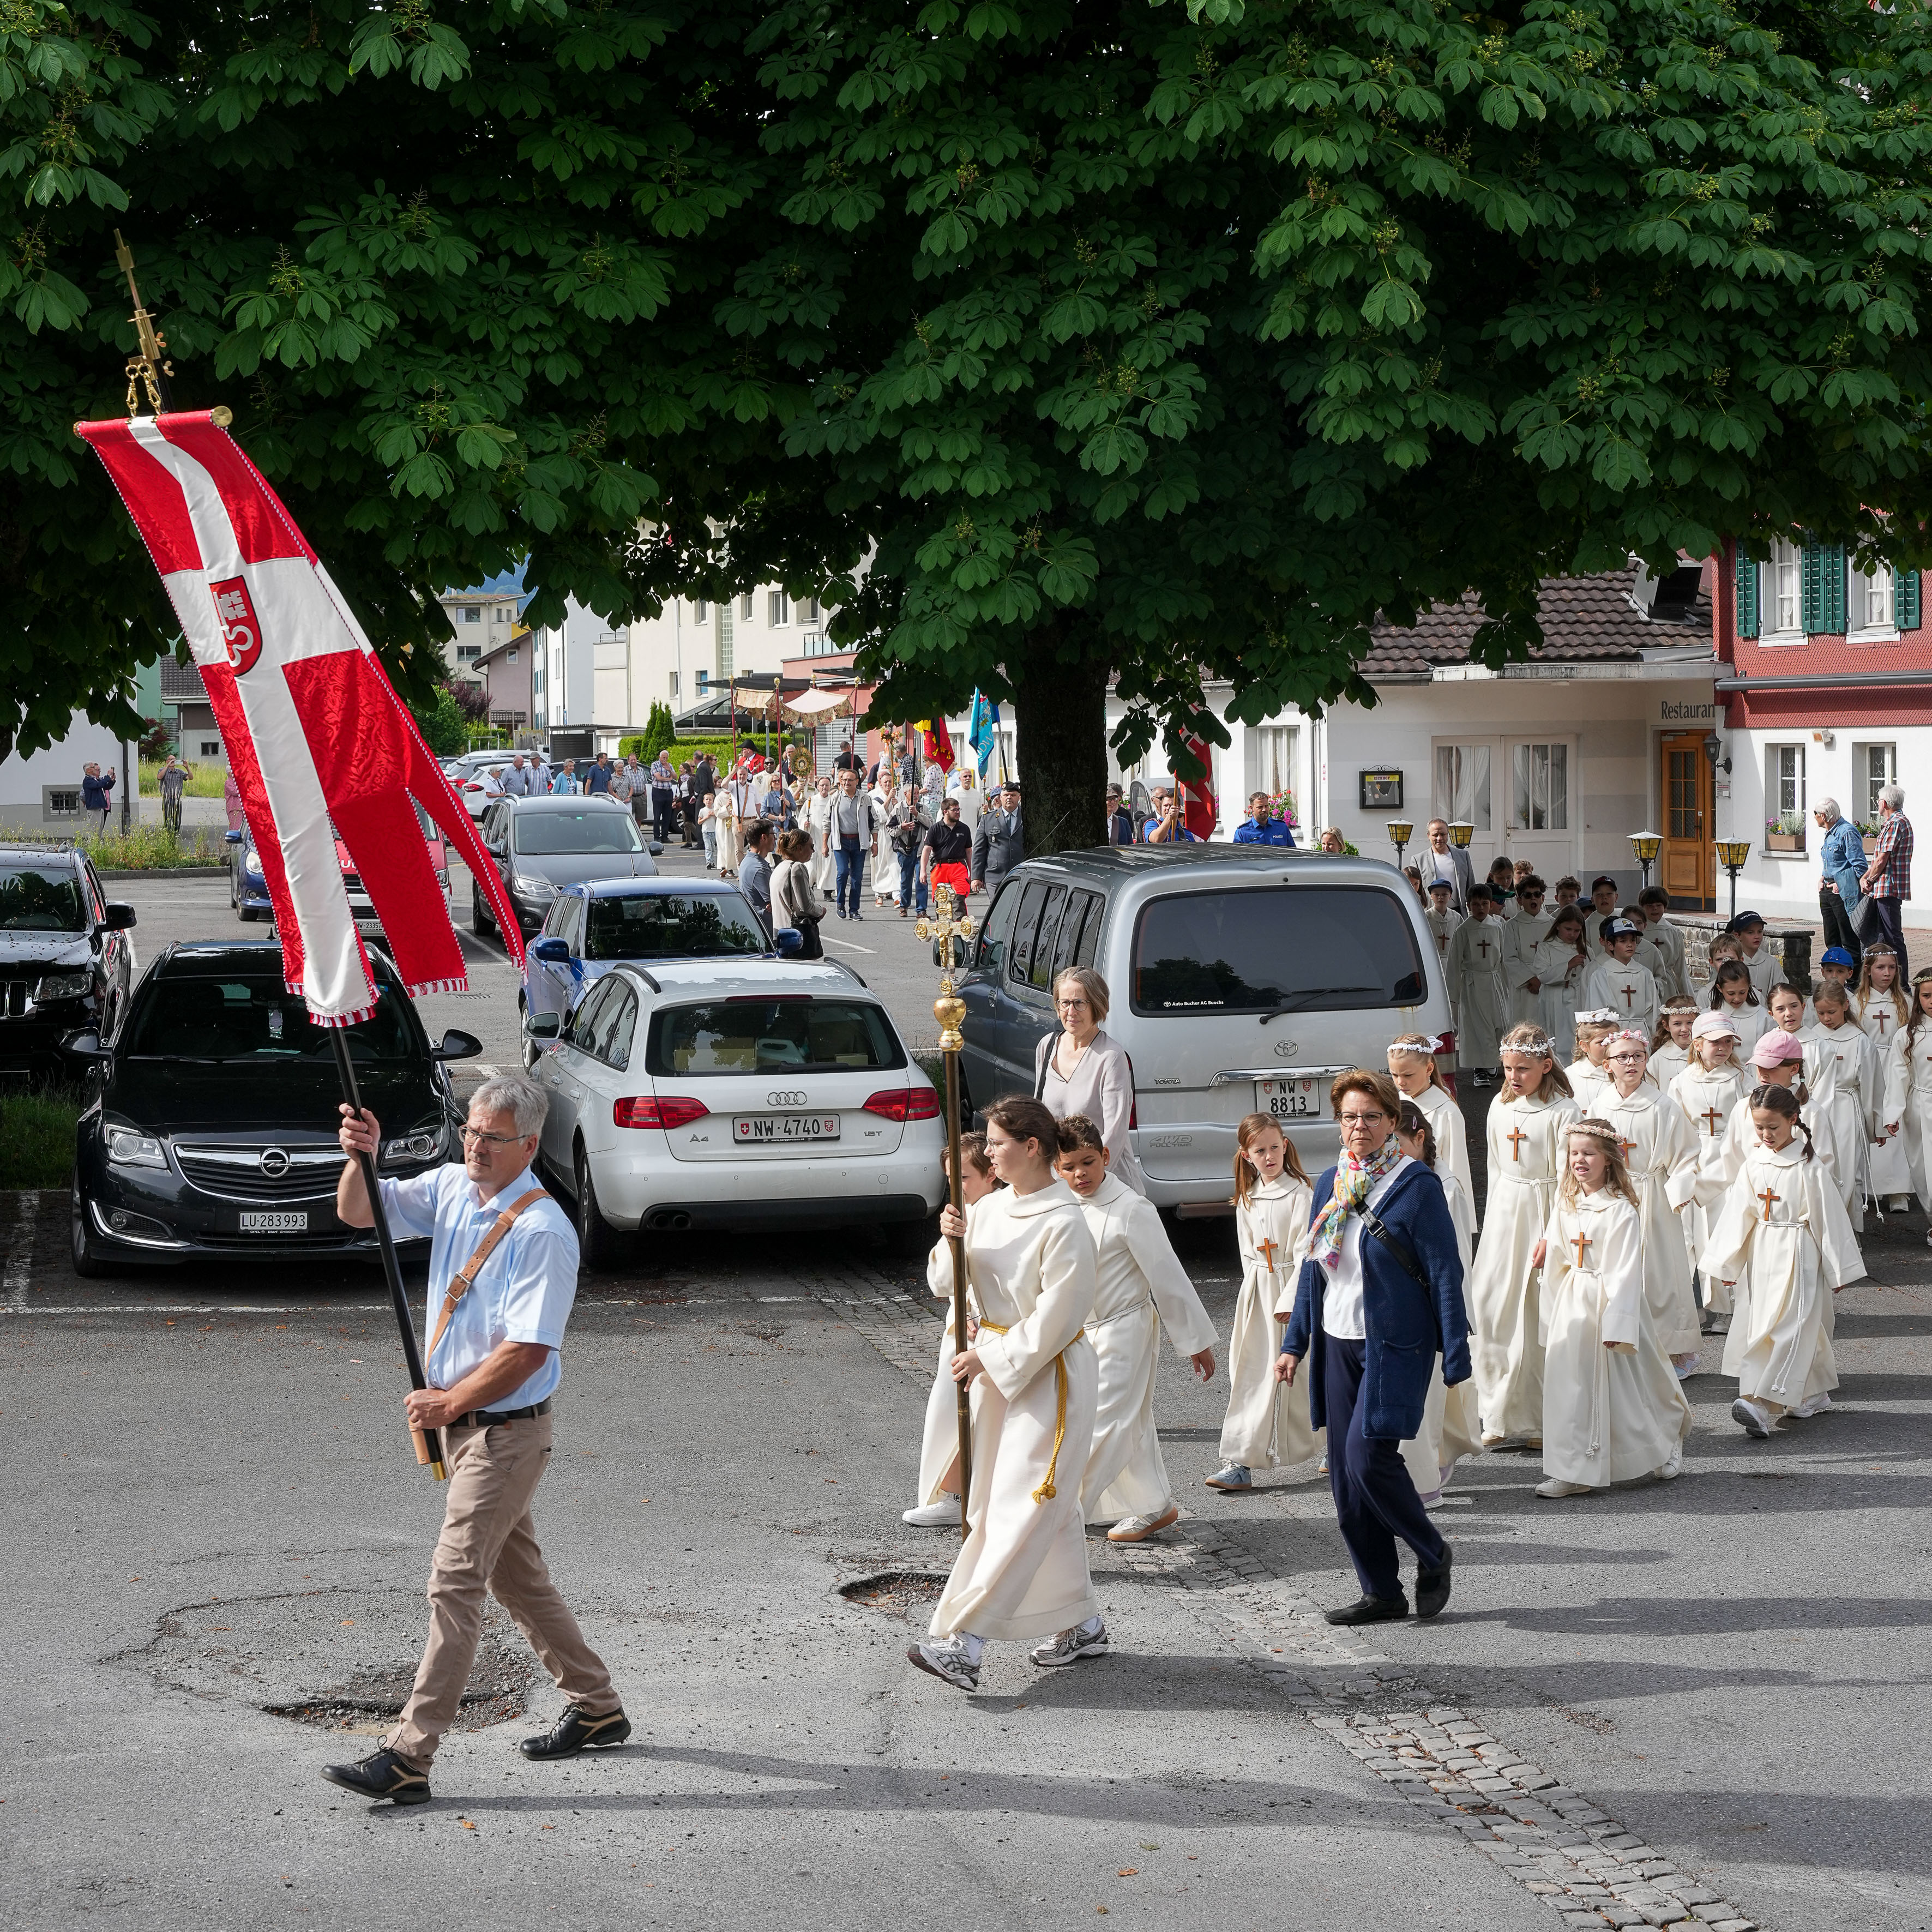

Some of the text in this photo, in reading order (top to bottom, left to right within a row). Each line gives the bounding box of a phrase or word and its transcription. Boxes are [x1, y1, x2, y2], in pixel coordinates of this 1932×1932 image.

[1661, 701, 1715, 719] Restauran
[1279, 1081, 1295, 1094] NW
[1271, 1096, 1307, 1113] 8813
[689, 1134, 709, 1142] A4
[1149, 1135, 1193, 1144] 4WD
